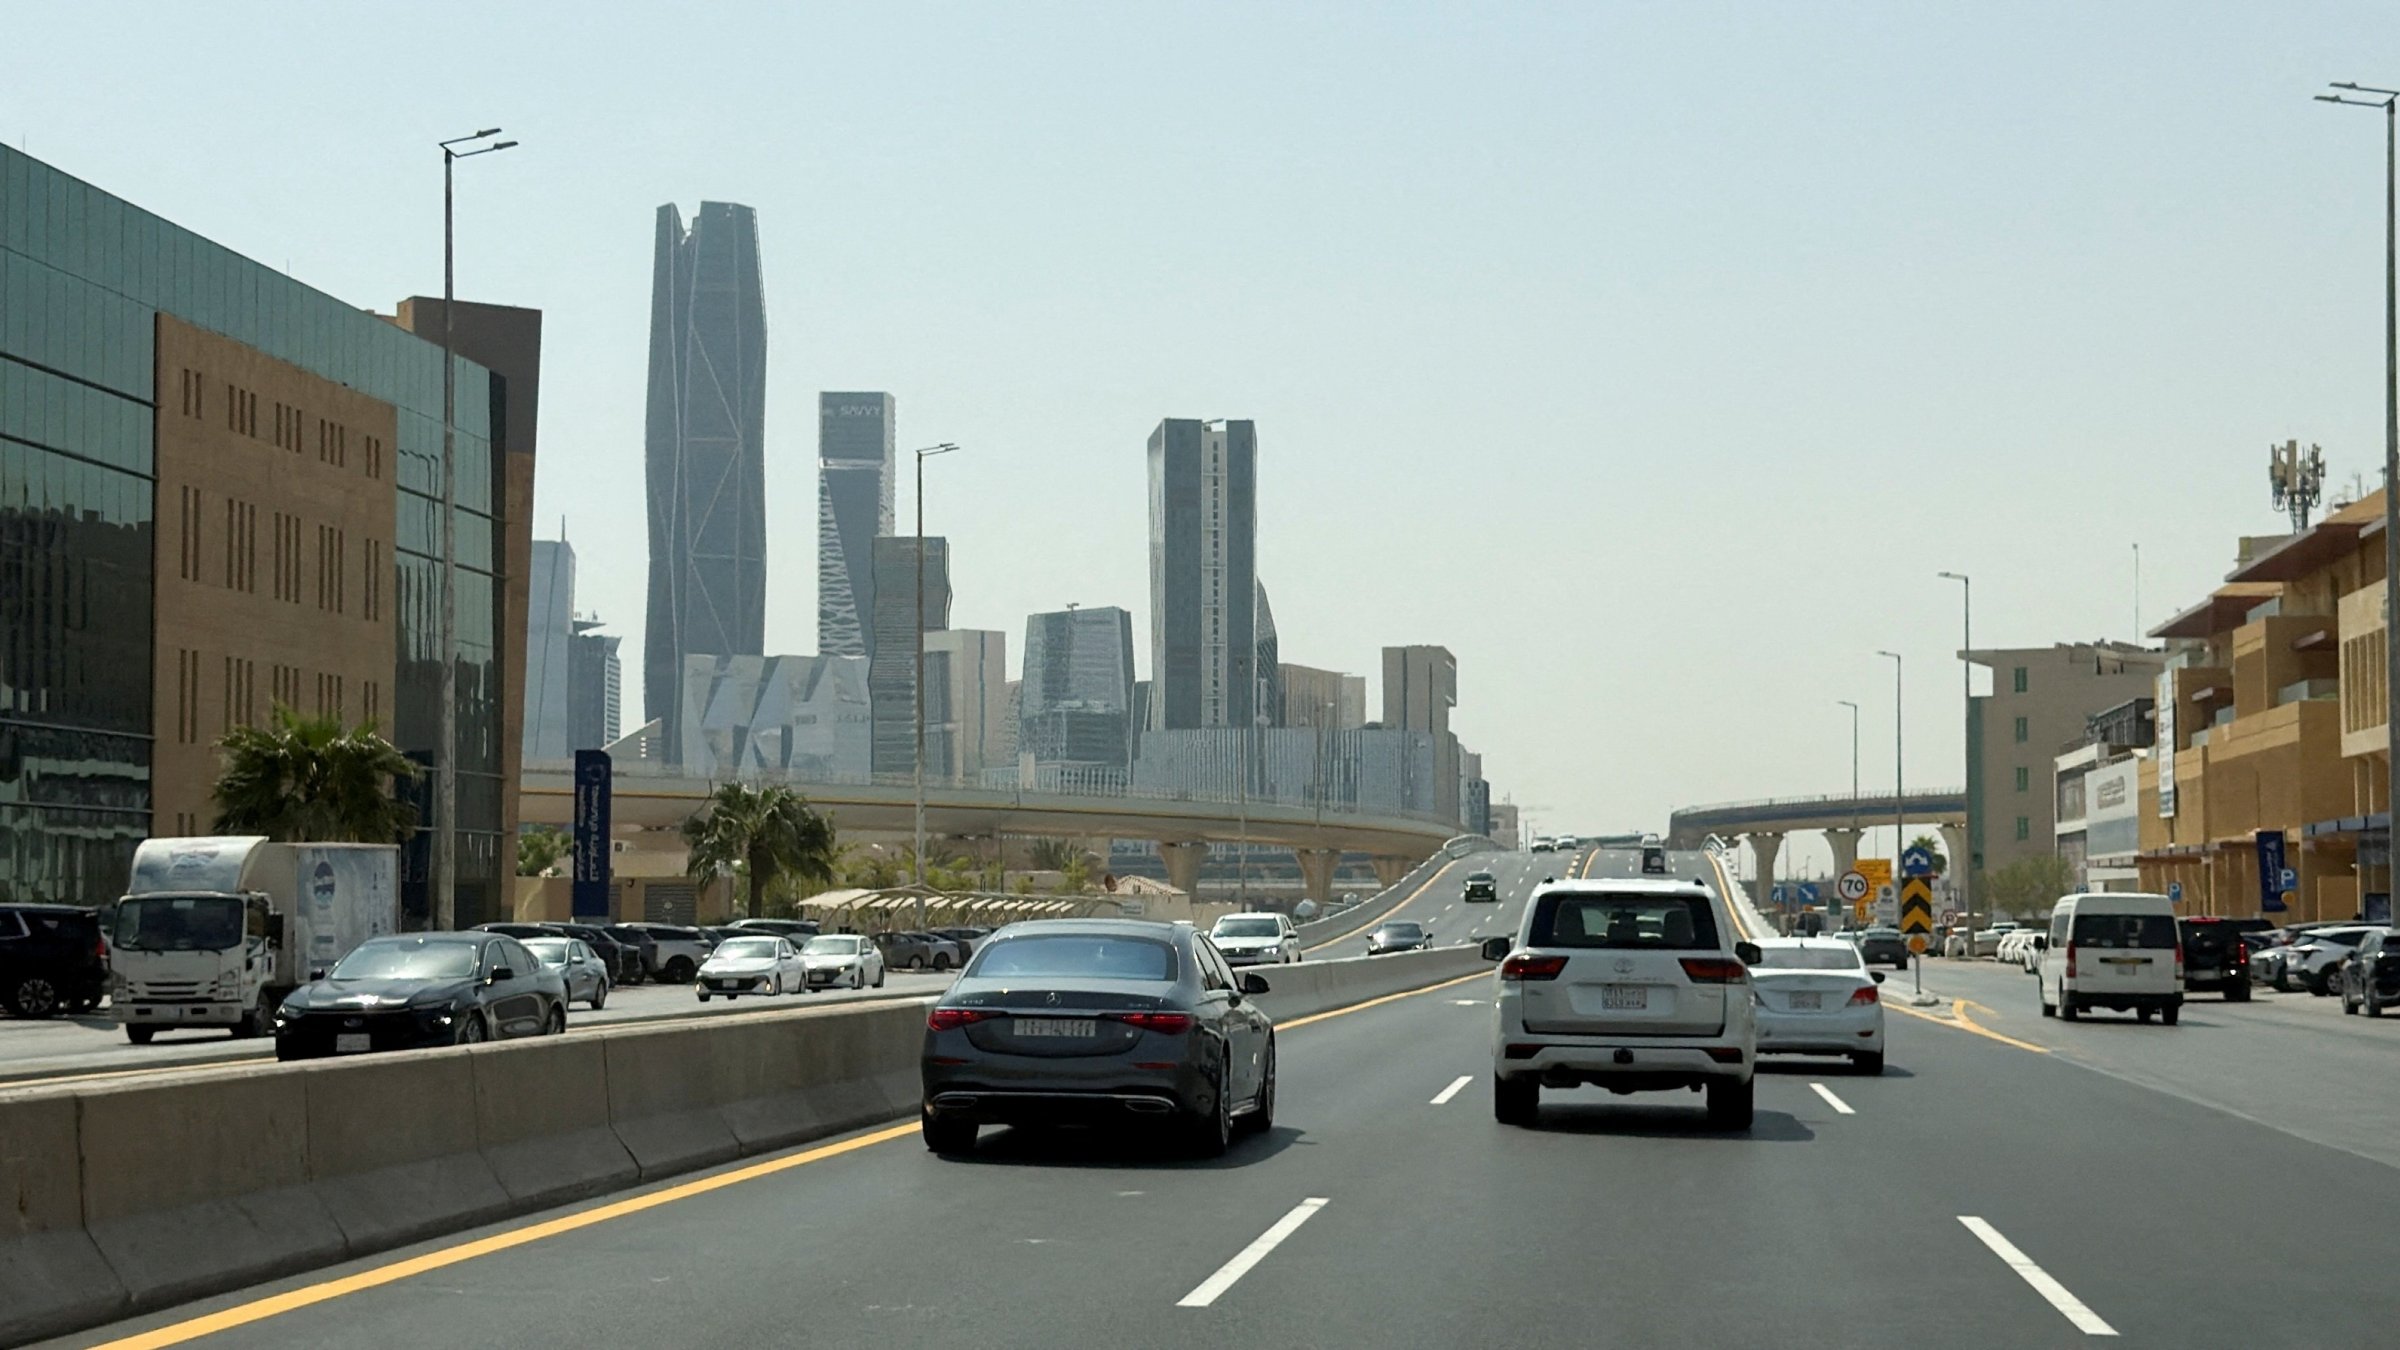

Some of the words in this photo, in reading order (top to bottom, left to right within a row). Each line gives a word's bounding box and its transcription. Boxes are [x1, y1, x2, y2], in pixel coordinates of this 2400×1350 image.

[841, 405, 880, 416] SAVVY
[2281, 869, 2294, 886] P
[1844, 879, 1865, 892] 70
